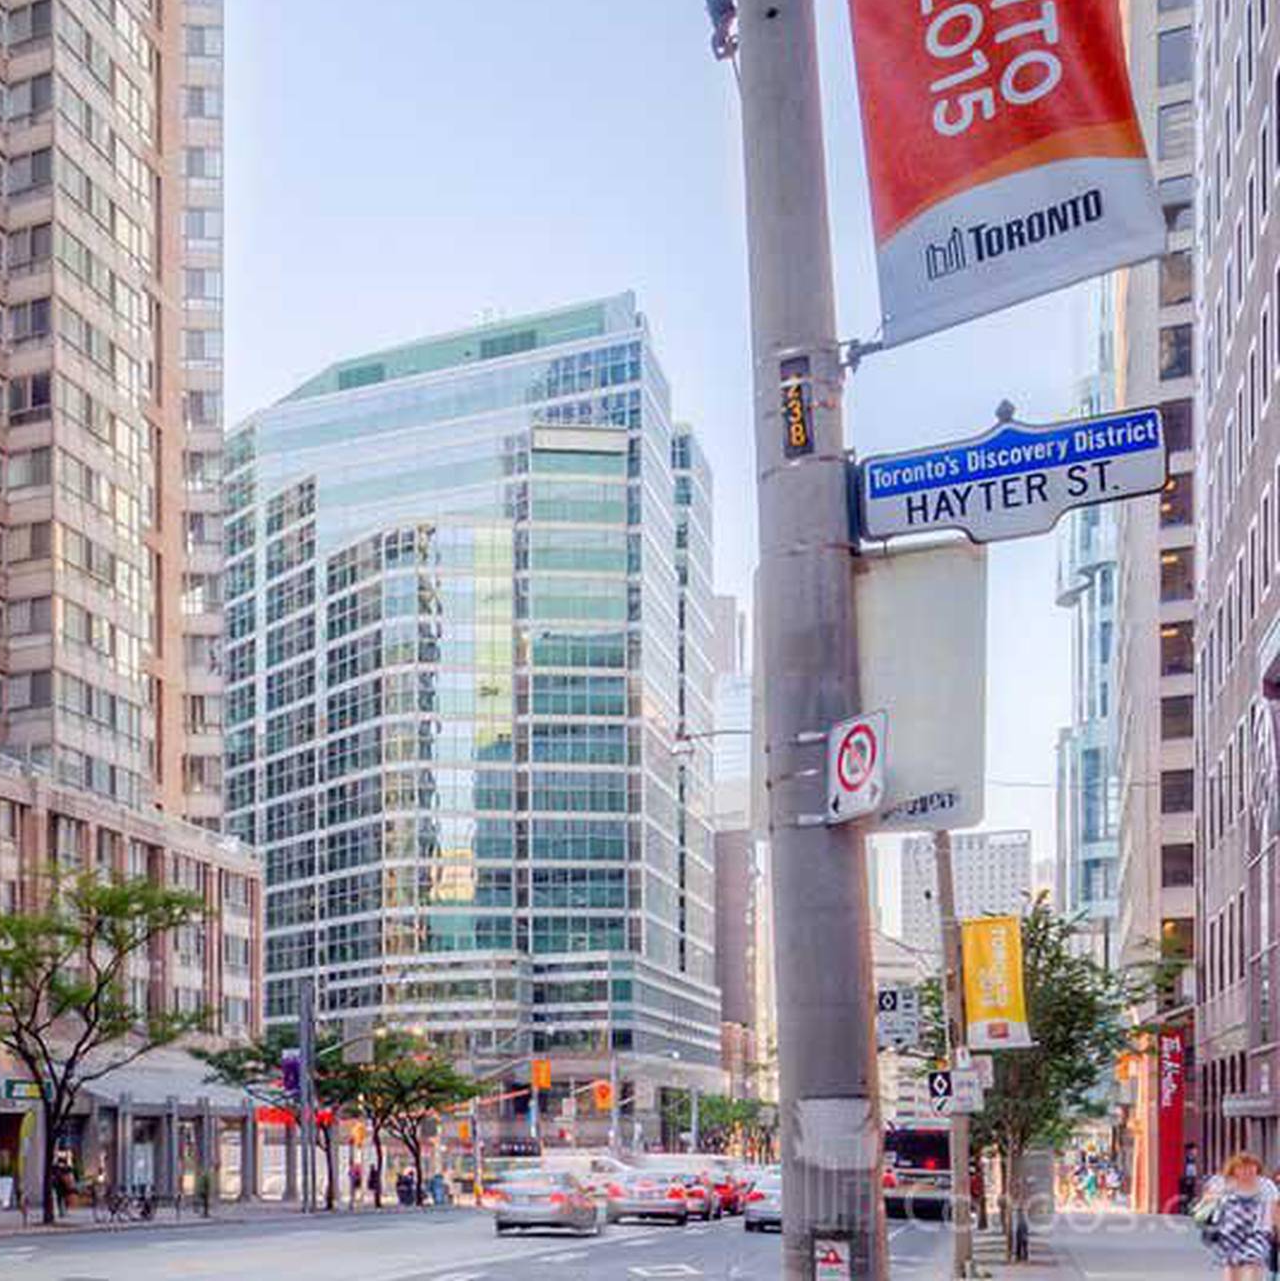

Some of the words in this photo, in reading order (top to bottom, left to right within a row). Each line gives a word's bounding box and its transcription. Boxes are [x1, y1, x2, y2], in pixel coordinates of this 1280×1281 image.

[967, 189, 1103, 263] TORONTO
[871, 456, 960, 490] Toronto's
[967, 440, 1068, 473] Discovery
[1074, 417, 1157, 454] District
[906, 472, 1049, 525] HAYTER
[1067, 460, 1120, 497] ST.
